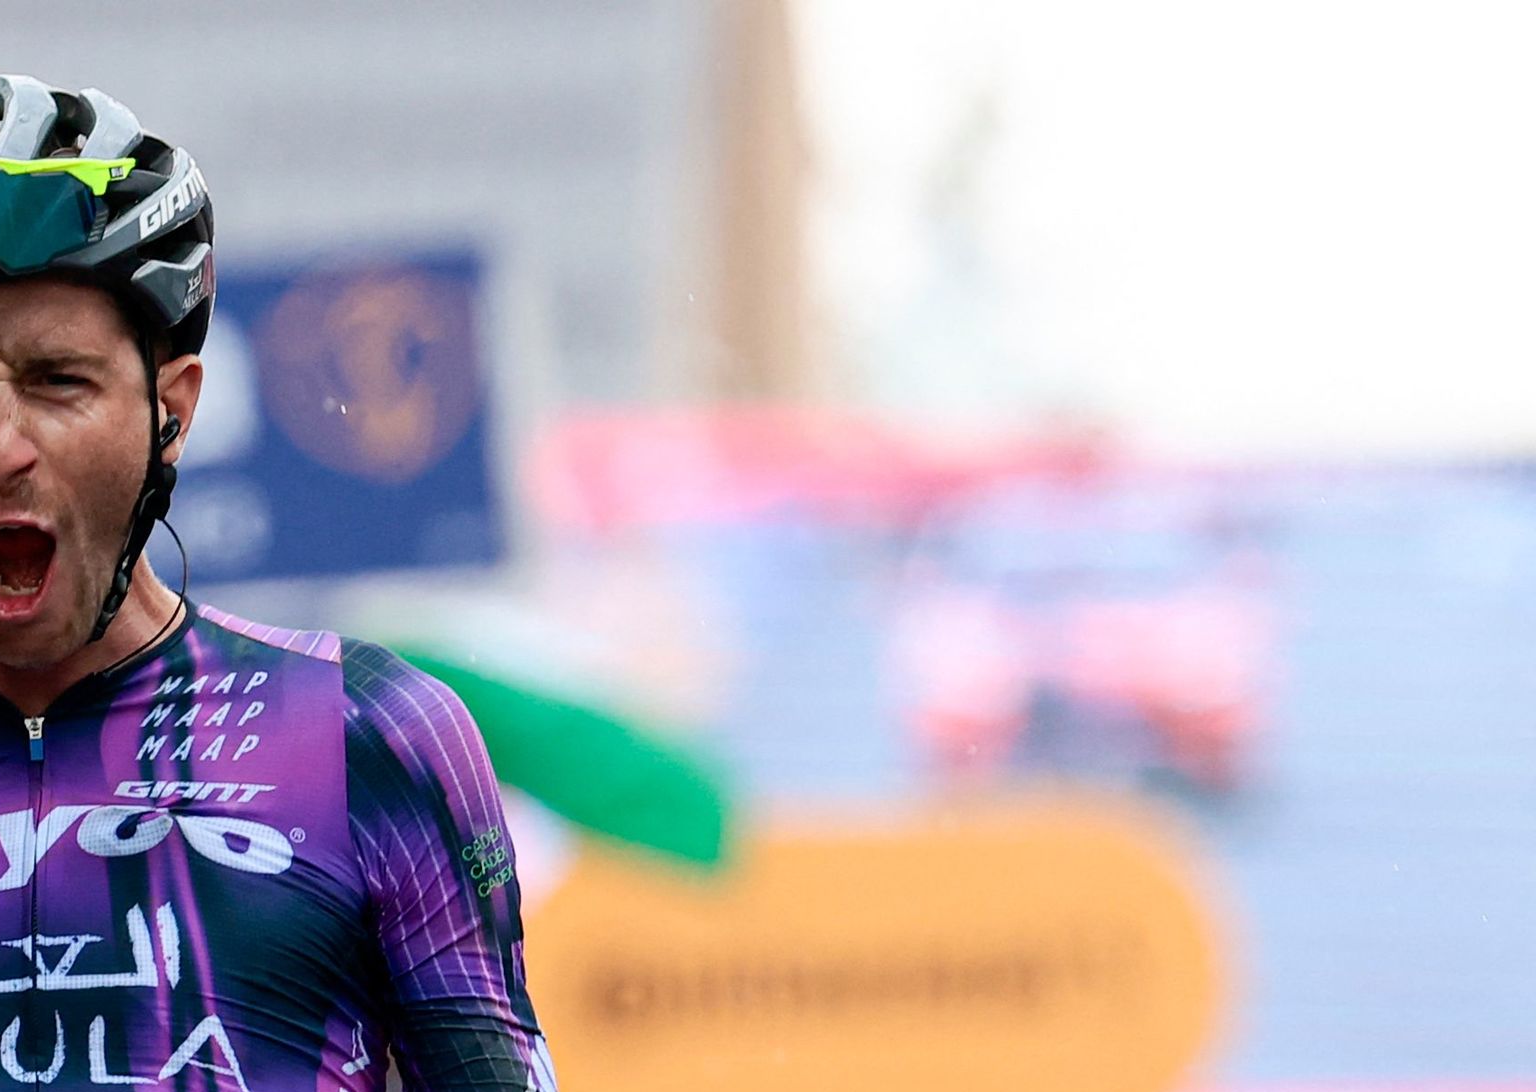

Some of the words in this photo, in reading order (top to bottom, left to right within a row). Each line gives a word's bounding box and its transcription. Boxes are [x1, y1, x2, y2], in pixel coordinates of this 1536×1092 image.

[140, 701, 265, 727] MAAP
[135, 734, 260, 761] MAAP
[114, 781, 278, 802] GIANT
